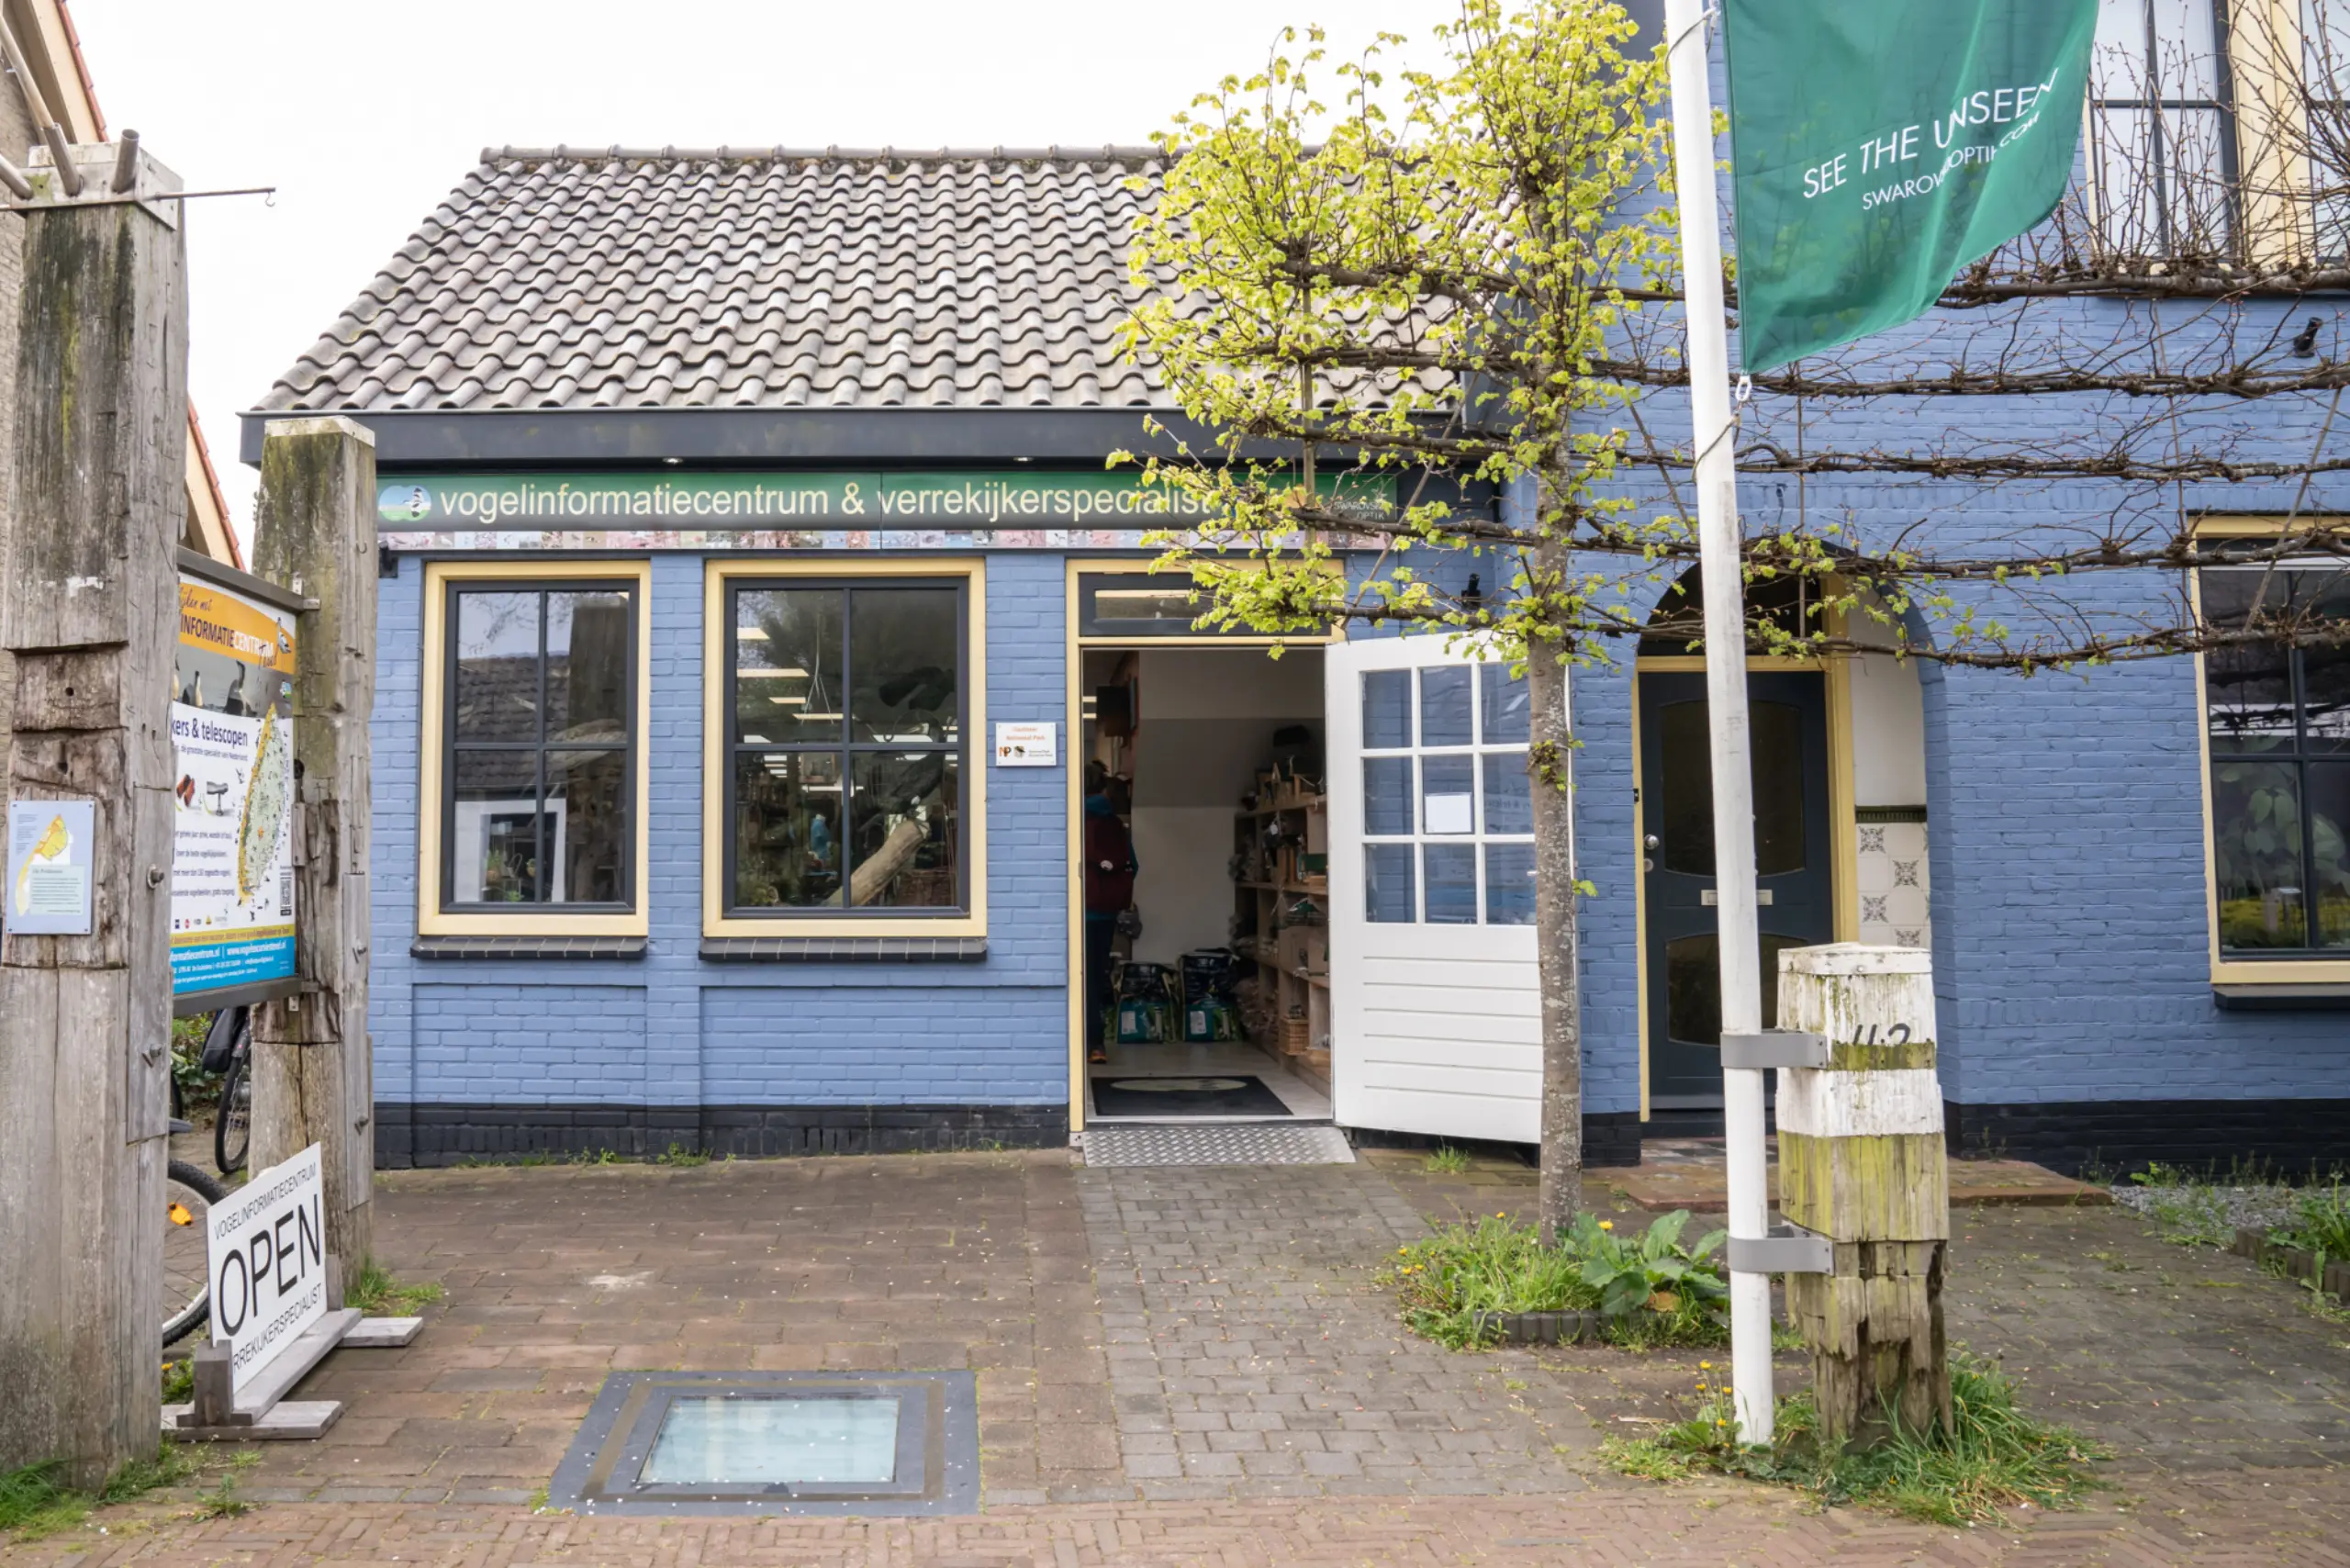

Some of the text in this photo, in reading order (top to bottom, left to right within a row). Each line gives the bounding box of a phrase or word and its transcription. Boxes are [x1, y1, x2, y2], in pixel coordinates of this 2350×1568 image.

[1802, 66, 2060, 199] SEE THE UNSEEN
[439, 481, 1212, 524] vogelinformatiecentrum & verrekijkerspecialist
[192, 717, 200, 739] &
[201, 720, 248, 749] telescopen
[214, 1161, 318, 1240] VOGELINFORMATIECENTRUM
[218, 1193, 321, 1338] OPEN
